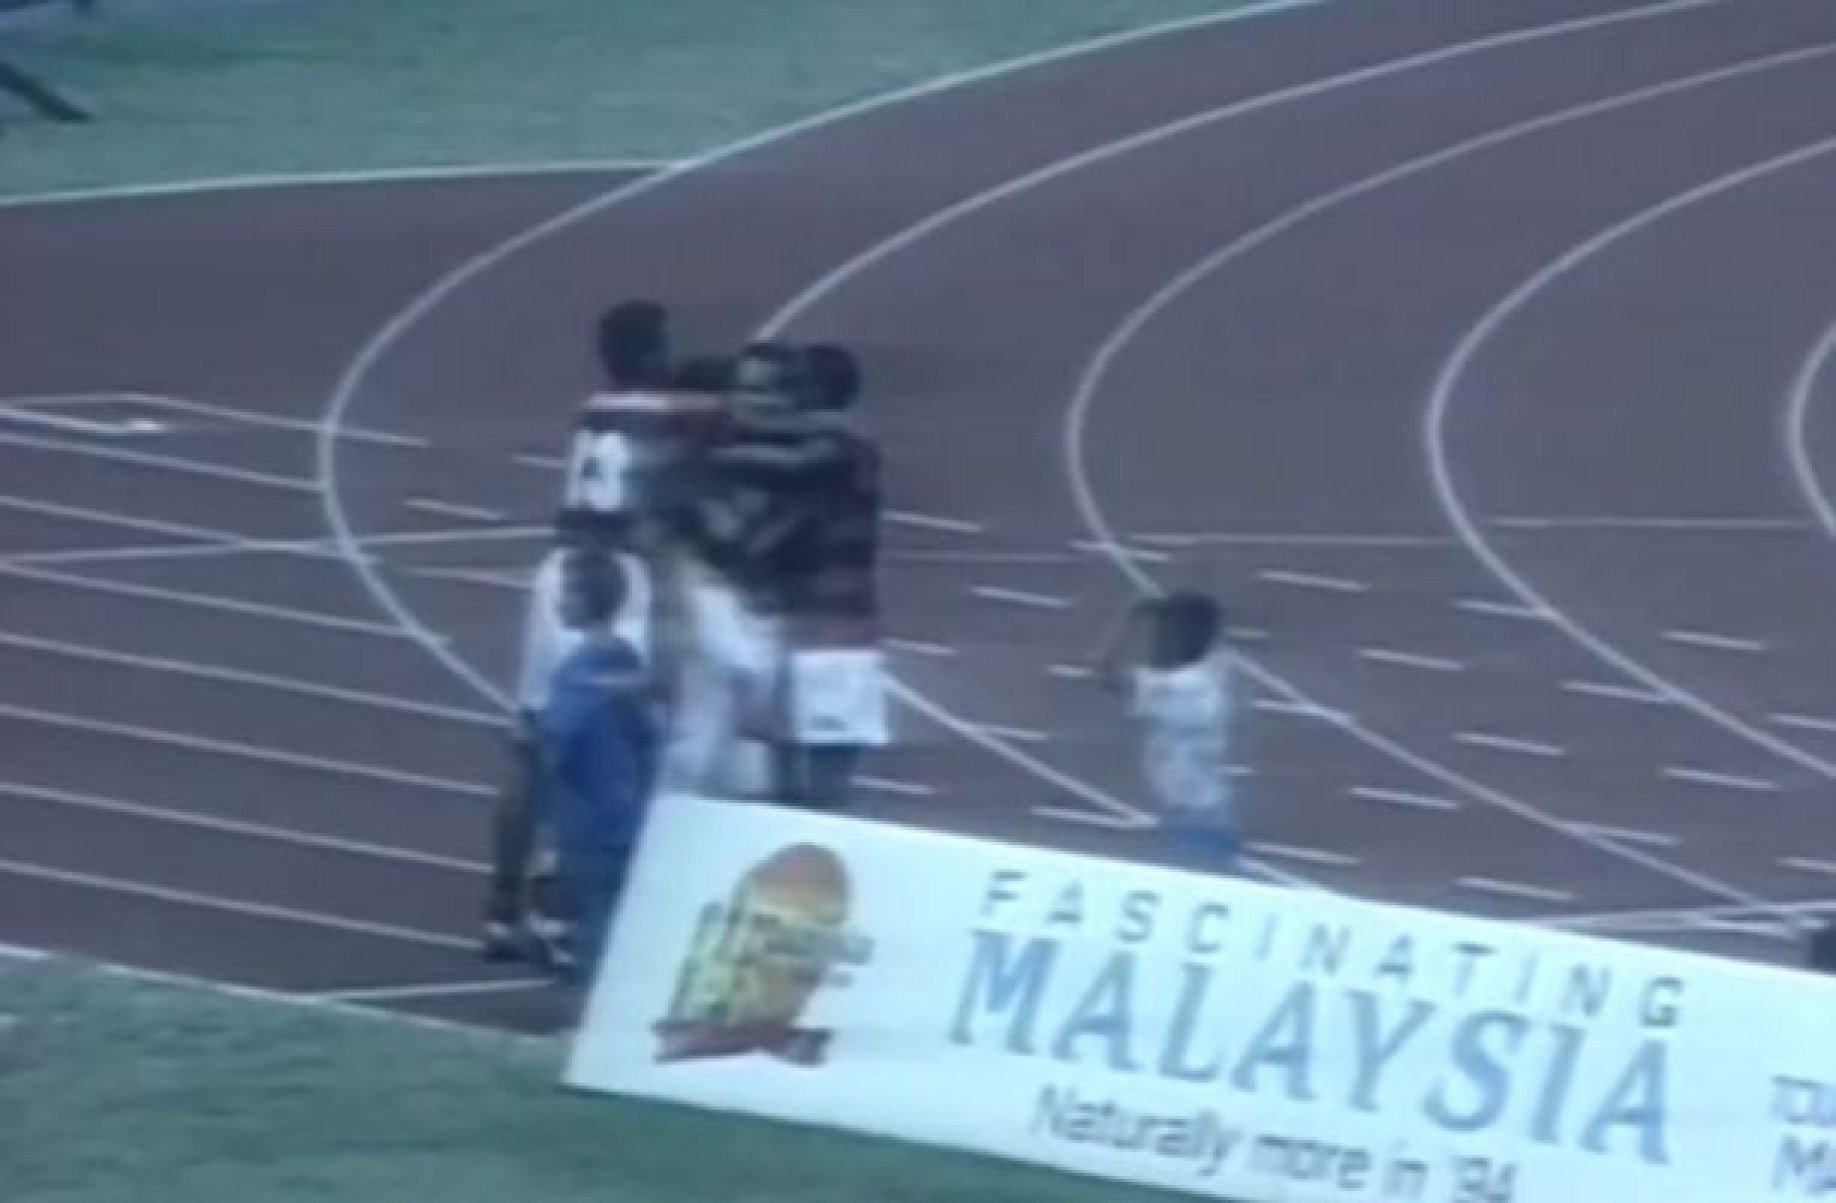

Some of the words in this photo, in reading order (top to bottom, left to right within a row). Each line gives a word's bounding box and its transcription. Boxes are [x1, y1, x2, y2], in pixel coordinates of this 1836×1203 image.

[979, 869, 1684, 1028] FASCINATING
[948, 928, 1670, 1165] MALAYSIA
[1031, 1085, 1241, 1177] Naturally
[1248, 1133, 1371, 1191] more
[1384, 1139, 1428, 1200] in
